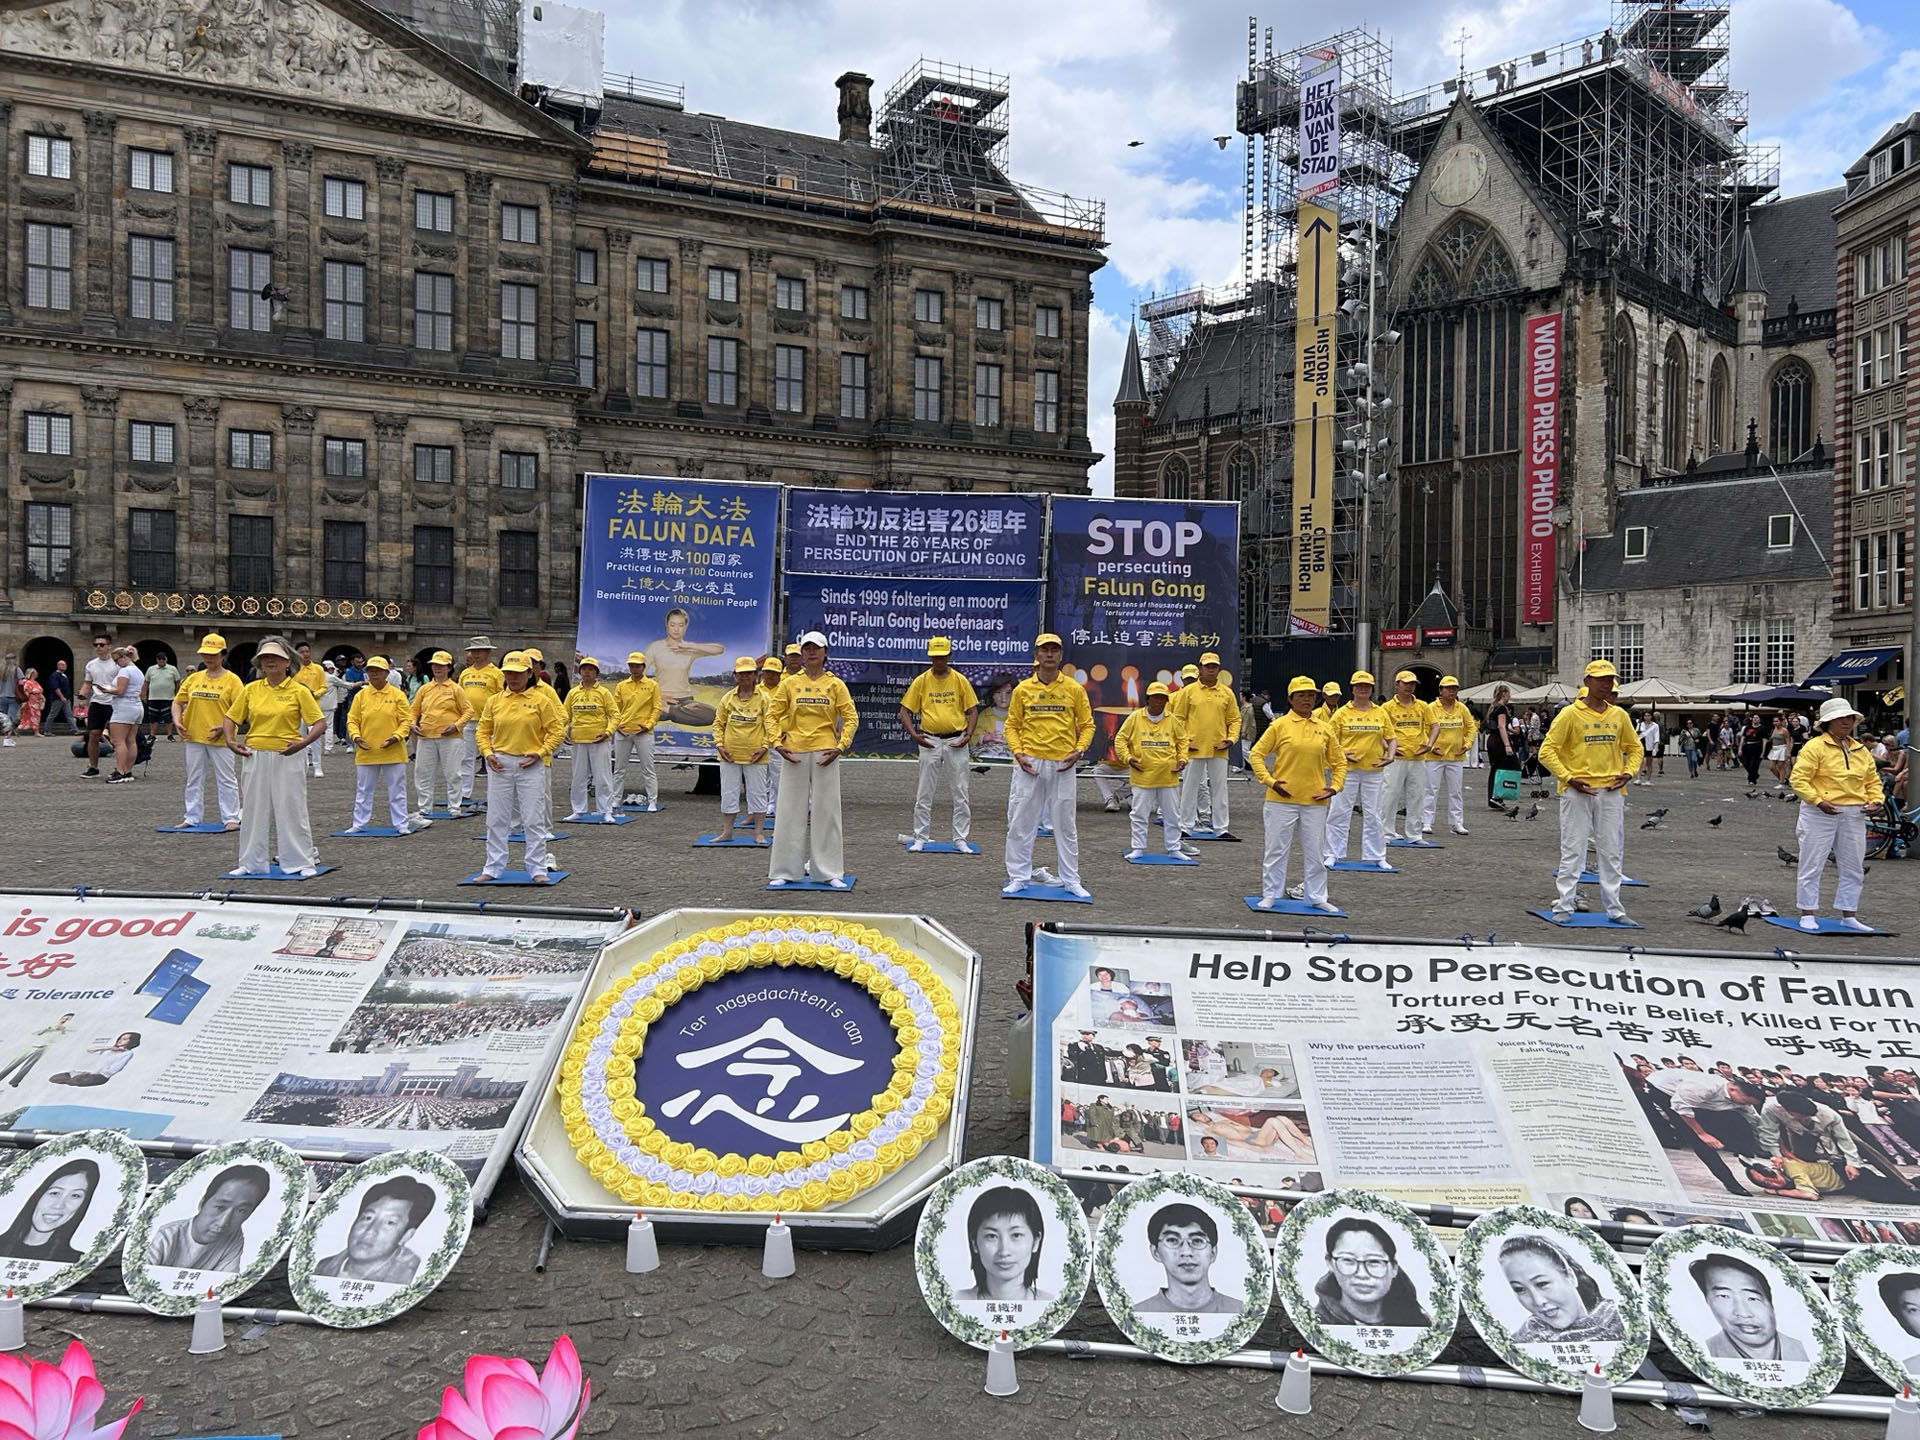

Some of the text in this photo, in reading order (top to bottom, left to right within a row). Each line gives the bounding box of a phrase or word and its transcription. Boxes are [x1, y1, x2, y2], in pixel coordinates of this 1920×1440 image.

[1306, 79, 1335, 101] HET
[1305, 97, 1334, 121] DAK
[1305, 115, 1335, 140] VAN
[1310, 135, 1329, 156] DE
[1300, 155, 1337, 175] STAD
[1303, 345, 1316, 382] VIEW
[1316, 328, 1330, 396] HISTORIC
[1531, 320, 1556, 615] WORLD PRESS PHOTO EXHIBITION
[617, 488, 752, 521] 法輪大法
[806, 503, 1027, 535] 法輪功反迫害26週年
[608, 518, 755, 547] FALUN DAFA
[836, 534, 992, 550] END THE 26 YEARS OF
[1086, 518, 1203, 558] STOP
[620, 547, 742, 567] 洪傳世界100國家
[804, 547, 1026, 566] PERSECUTION OF FALUN GONG
[1299, 503, 1312, 592] THE CHURCH
[1313, 527, 1326, 572] CLIMB
[606, 562, 754, 578] Practiced in over 100 Countries
[1097, 561, 1192, 577] persecuting
[622, 576, 736, 595] 上億人身心受益
[1084, 577, 1206, 603] Falun Gong
[596, 590, 758, 608] Benefiting over 100 Million People
[821, 588, 1008, 612] Sinds 1999 foltering en moord
[1147, 601, 1183, 609] thousands
[824, 611, 1004, 632] van Falun Gong beoefenaars
[1148, 619, 1172, 627] beliefs
[828, 632, 875, 648] China's
[985, 638, 1030, 654] regime
[1071, 628, 1221, 648] 停止迫害法輪功
[2, 908, 197, 945] is good
[253, 964, 282, 975] What
[293, 967, 324, 977] Falun
[324, 969, 357, 979] Dafa?
[1188, 952, 1915, 1008] Help Stop Persecution of Falun
[25, 988, 115, 1000] Tolerance
[680, 987, 865, 1046] Ter nagedachtenis aan
[1386, 992, 1510, 1008] Tortured
[1514, 990, 1558, 1007] For
[1567, 995, 1637, 1016] Their
[1646, 1003, 1734, 1028] Belief,
[1741, 1011, 1822, 1031] Killed
[1829, 1016, 1877, 1033] For
[1396, 1011, 1713, 1049] 承受无名苦难
[1308, 1042, 1334, 1051] Why
[1358, 1042, 1426, 1052] persecution?
[1497, 1040, 1526, 1048] Voices
[1538, 1039, 1574, 1051] Support
[1546, 1047, 1571, 1056] Gong
[660, 1017, 865, 1144] 念
[341, 1292, 364, 1302] 吉林
[1754, 1372, 1782, 1381] 河北
